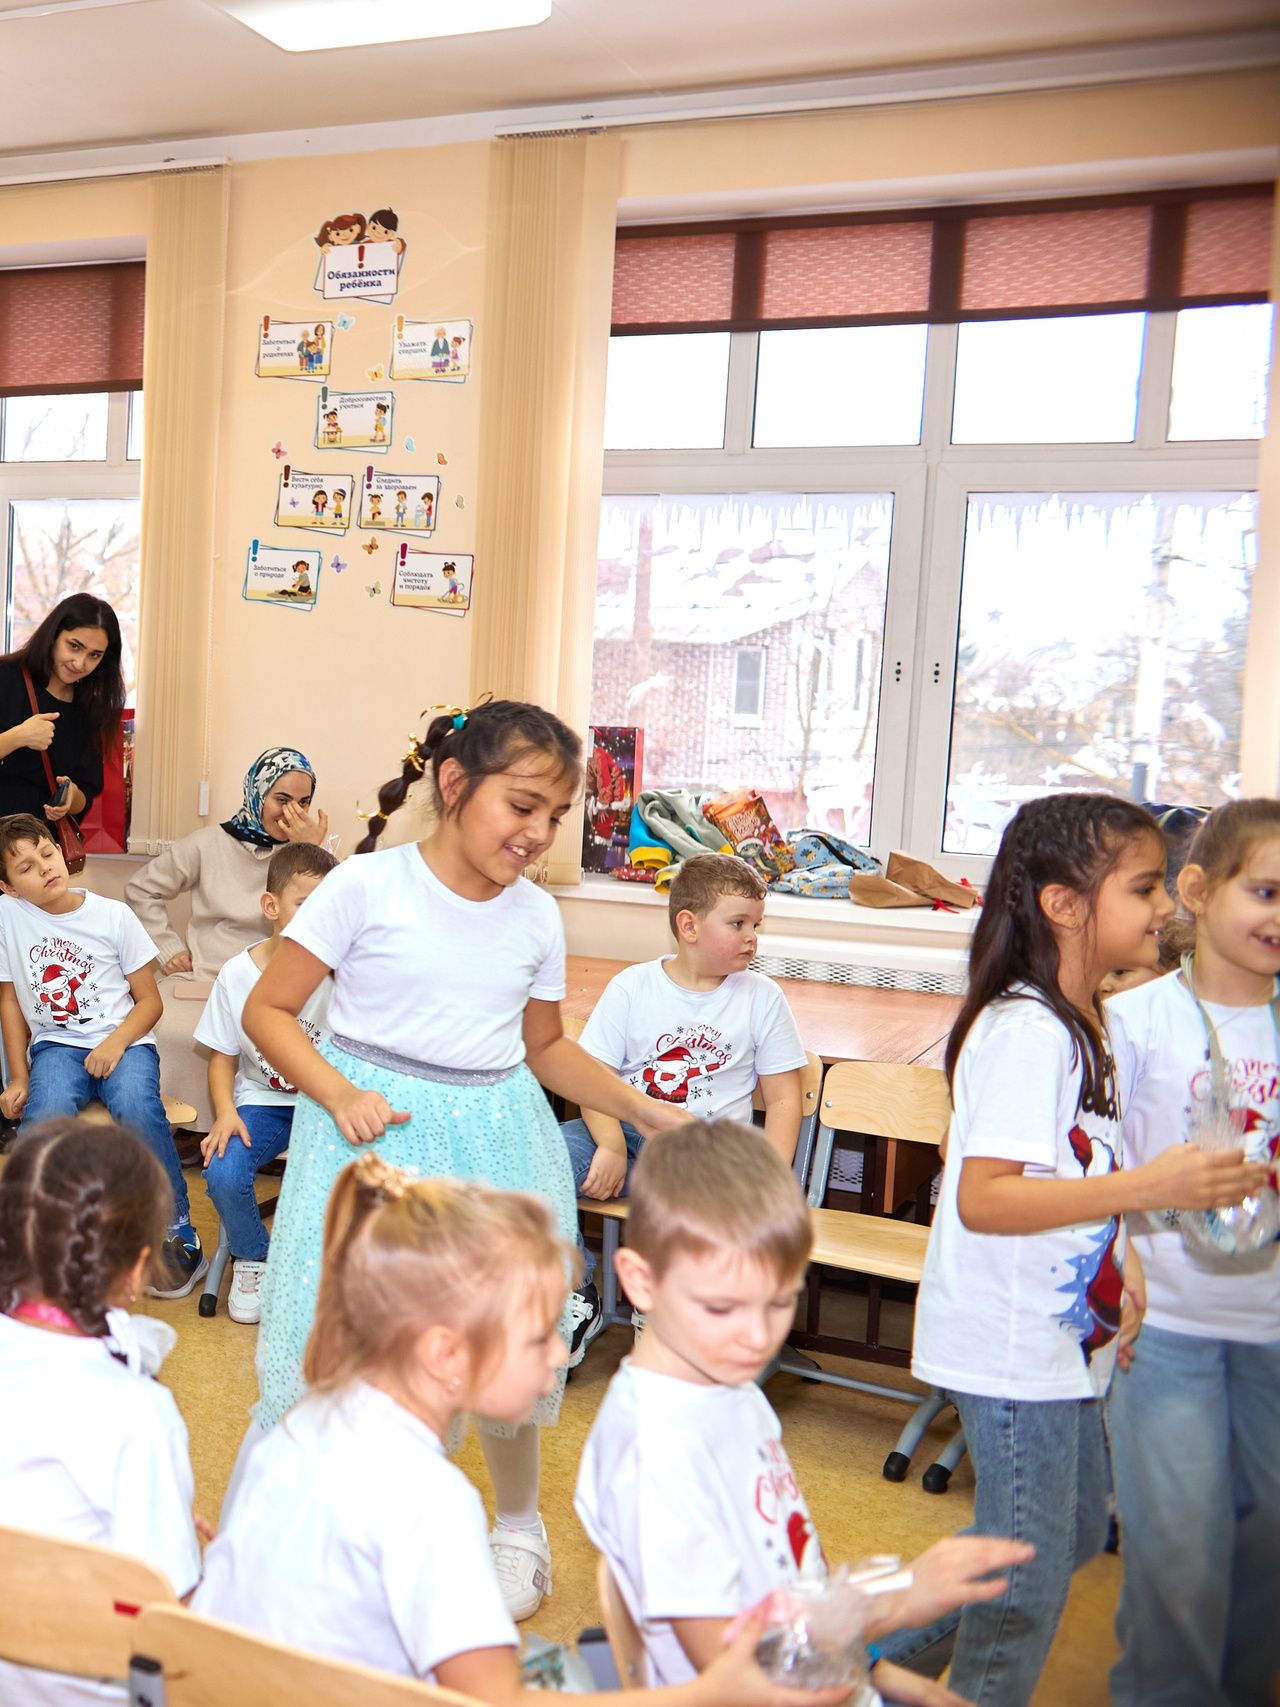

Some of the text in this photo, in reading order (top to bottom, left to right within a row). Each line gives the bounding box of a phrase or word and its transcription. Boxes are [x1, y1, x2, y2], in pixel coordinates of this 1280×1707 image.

[327, 269, 395, 280] Обязанности
[339, 279, 382, 291] ребёнка
[253, 564, 287, 572] Заботиться
[399, 570, 434, 578] Соблюдать
[50, 937, 83, 954] Merry
[29, 944, 96, 974] Christmas
